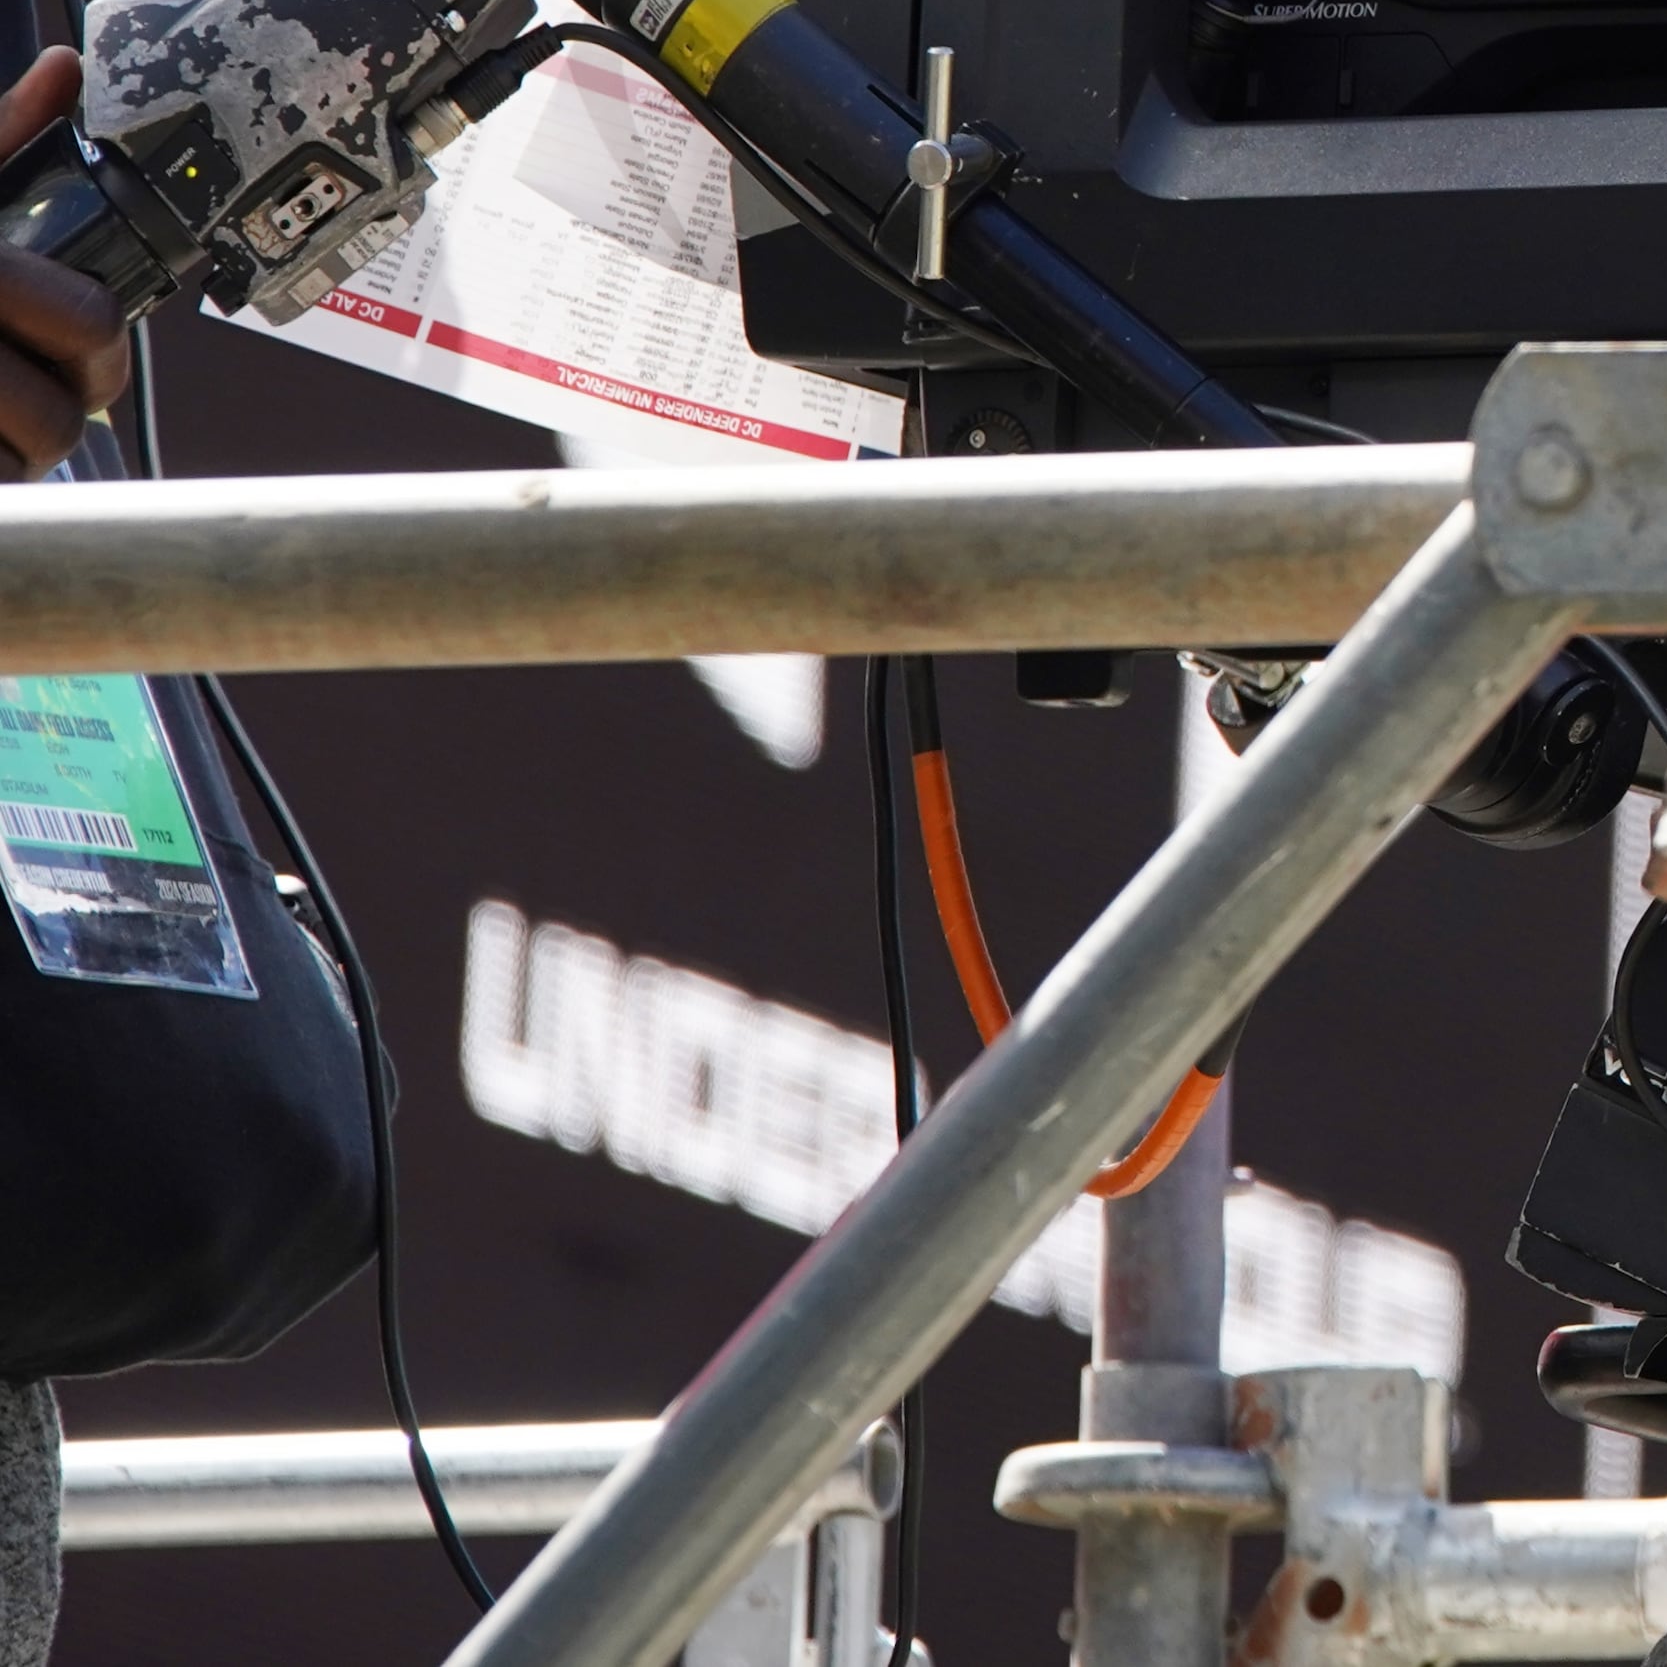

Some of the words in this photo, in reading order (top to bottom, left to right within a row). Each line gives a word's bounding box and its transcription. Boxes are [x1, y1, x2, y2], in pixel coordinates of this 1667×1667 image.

[165, 146, 197, 178] POWER
[366, 279, 392, 294] Name
[356, 299, 385, 322] DC
[553, 365, 654, 408] NUMERICAL
[653, 396, 741, 432] DEFENDERS
[740, 418, 763, 437] DC
